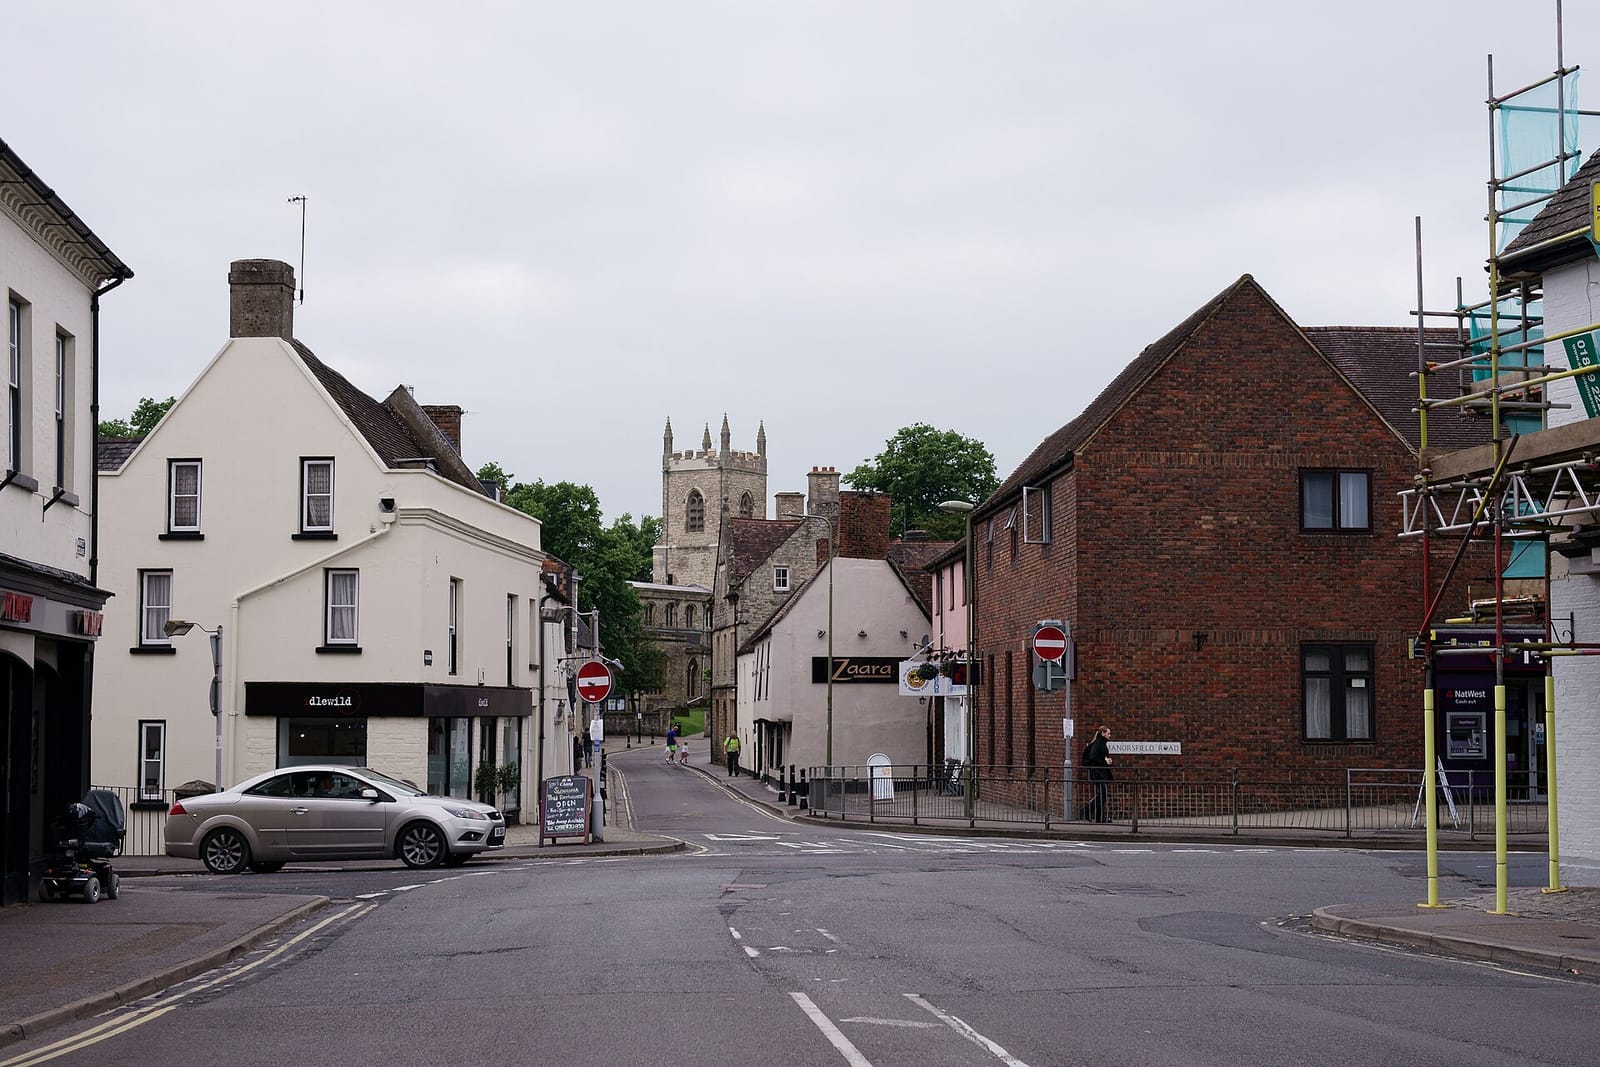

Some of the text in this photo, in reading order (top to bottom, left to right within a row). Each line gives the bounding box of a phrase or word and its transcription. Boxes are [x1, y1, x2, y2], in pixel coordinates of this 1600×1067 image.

[1577, 340, 1596, 383] 0189
[832, 658, 892, 681] Zaara
[1454, 689, 1486, 698] NatWest
[1158, 743, 1180, 752] ROAD
[556, 800, 577, 808] OPEN
